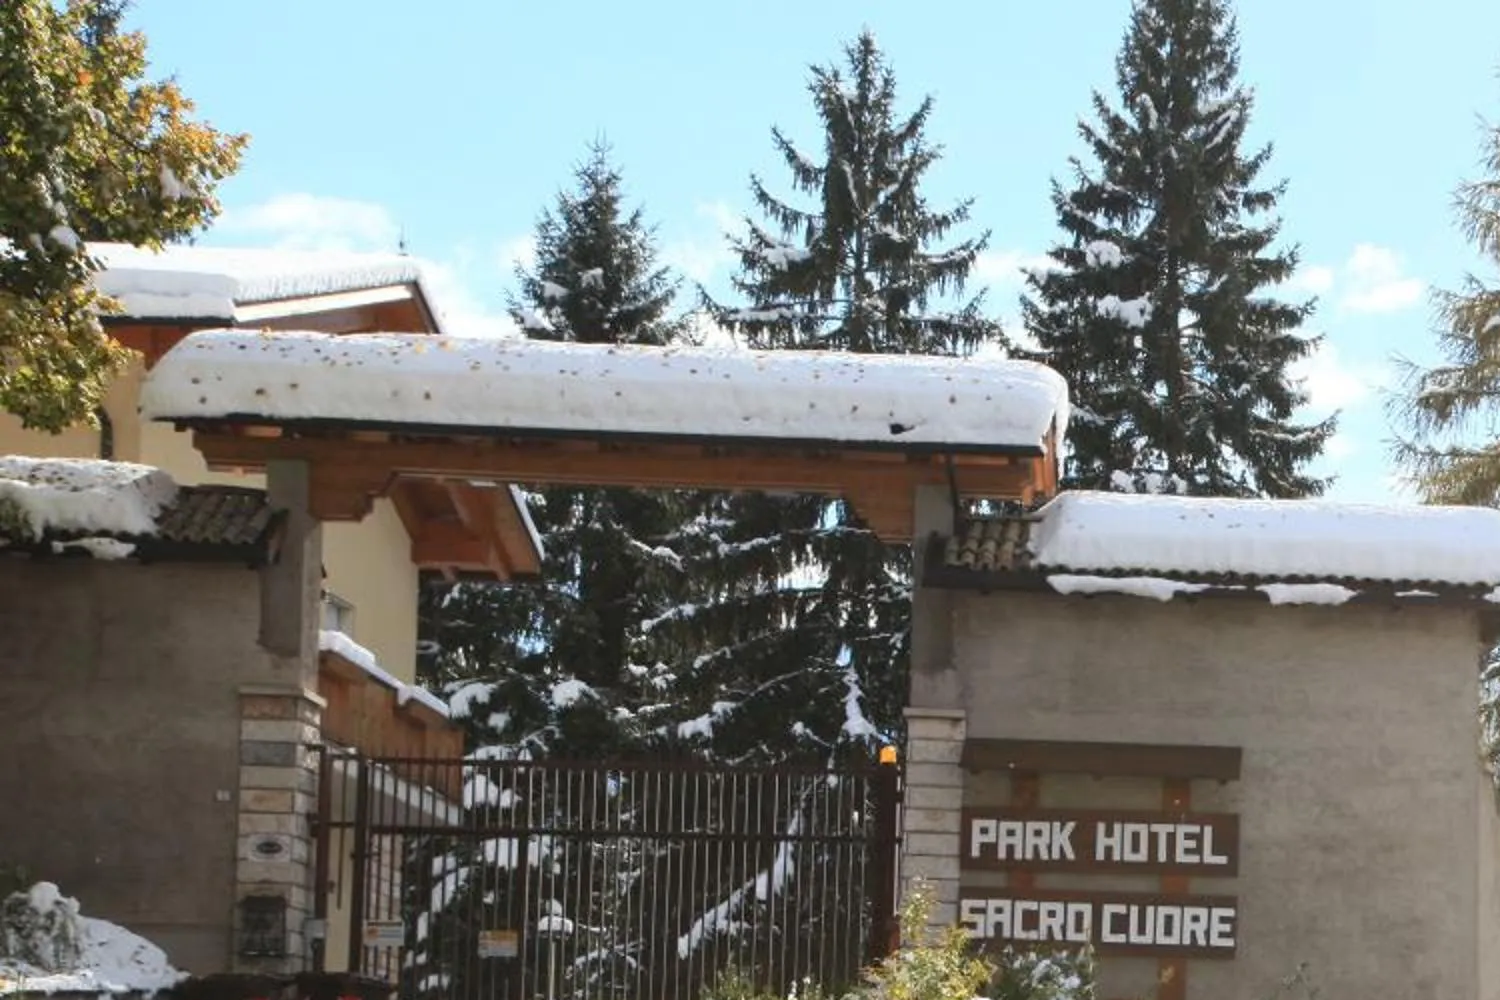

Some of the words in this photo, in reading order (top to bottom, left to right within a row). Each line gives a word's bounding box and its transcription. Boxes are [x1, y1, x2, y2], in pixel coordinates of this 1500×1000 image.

[971, 819, 1077, 860] PARK
[1095, 822, 1228, 864] HOTEL
[960, 899, 1092, 942] SACRO
[1101, 904, 1235, 947] CUORE
